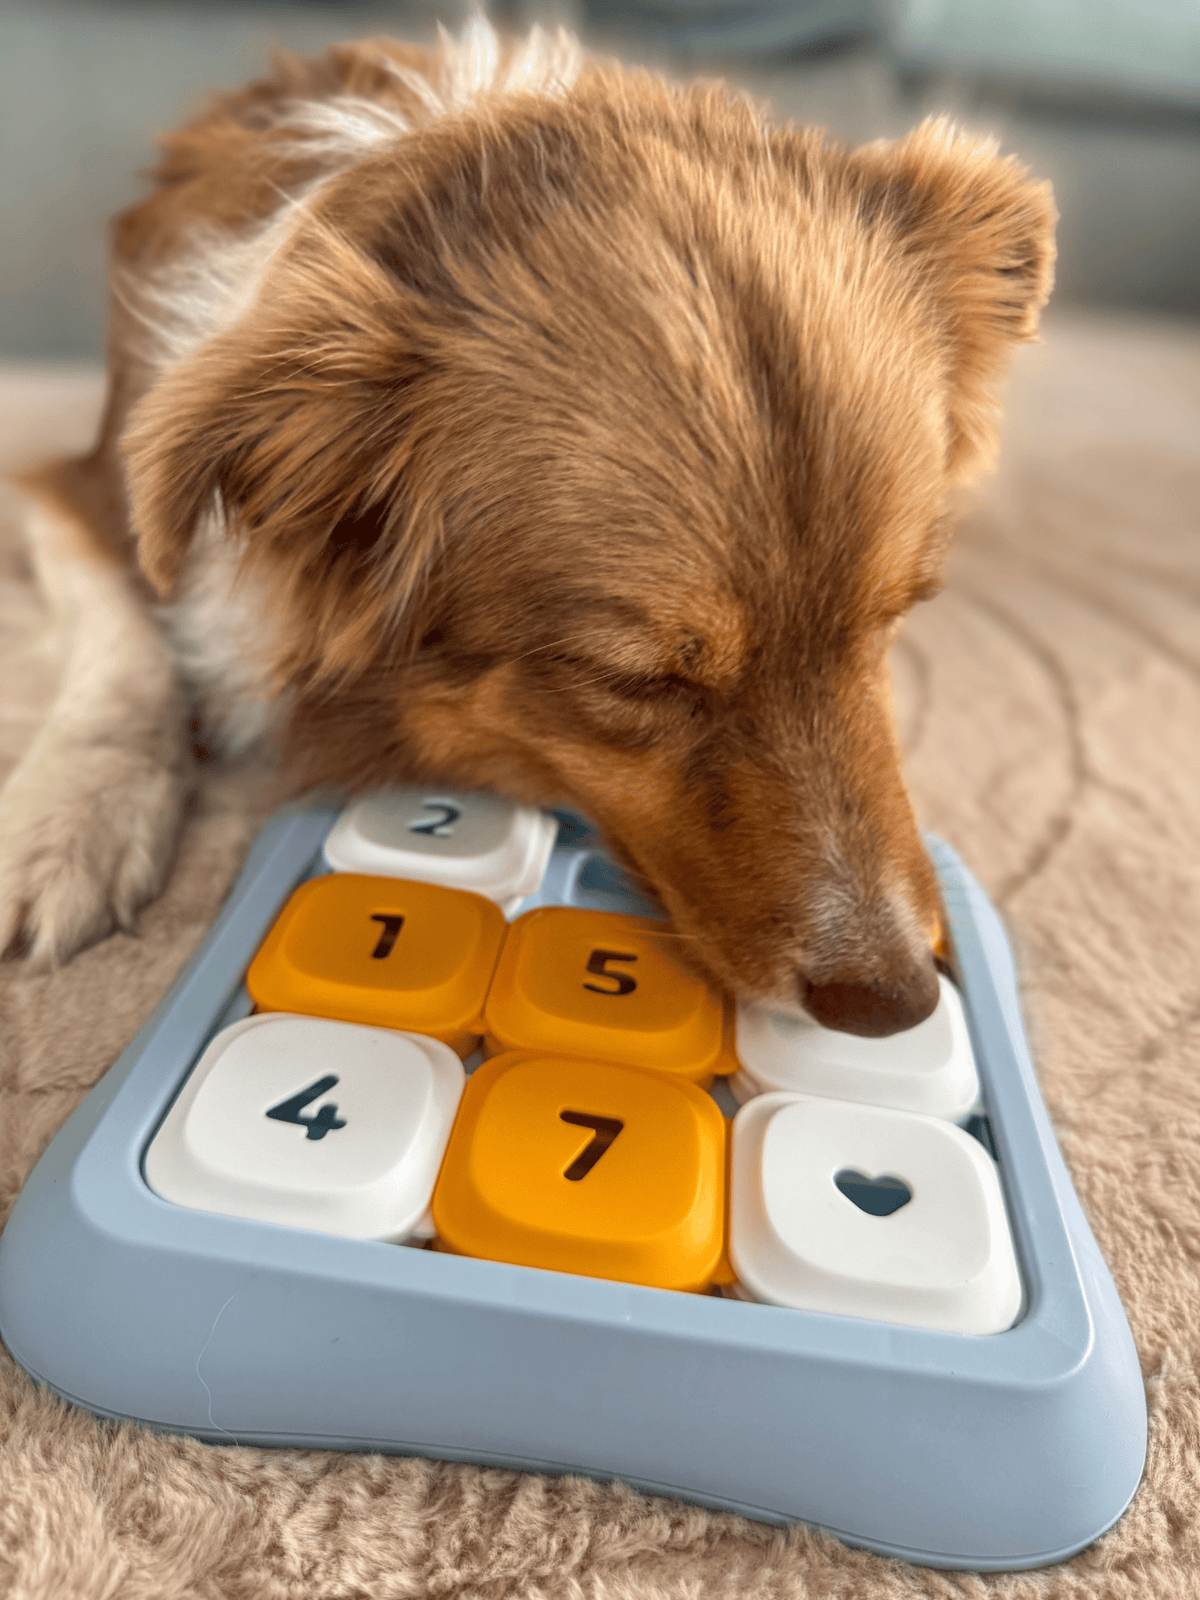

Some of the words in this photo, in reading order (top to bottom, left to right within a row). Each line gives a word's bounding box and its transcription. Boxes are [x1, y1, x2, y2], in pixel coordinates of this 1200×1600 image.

[408, 802, 461, 837] 2
[370, 913, 405, 960] 1
[583, 949, 639, 996] 5
[265, 1074, 347, 1141] 4
[559, 1109, 625, 1181] 7
